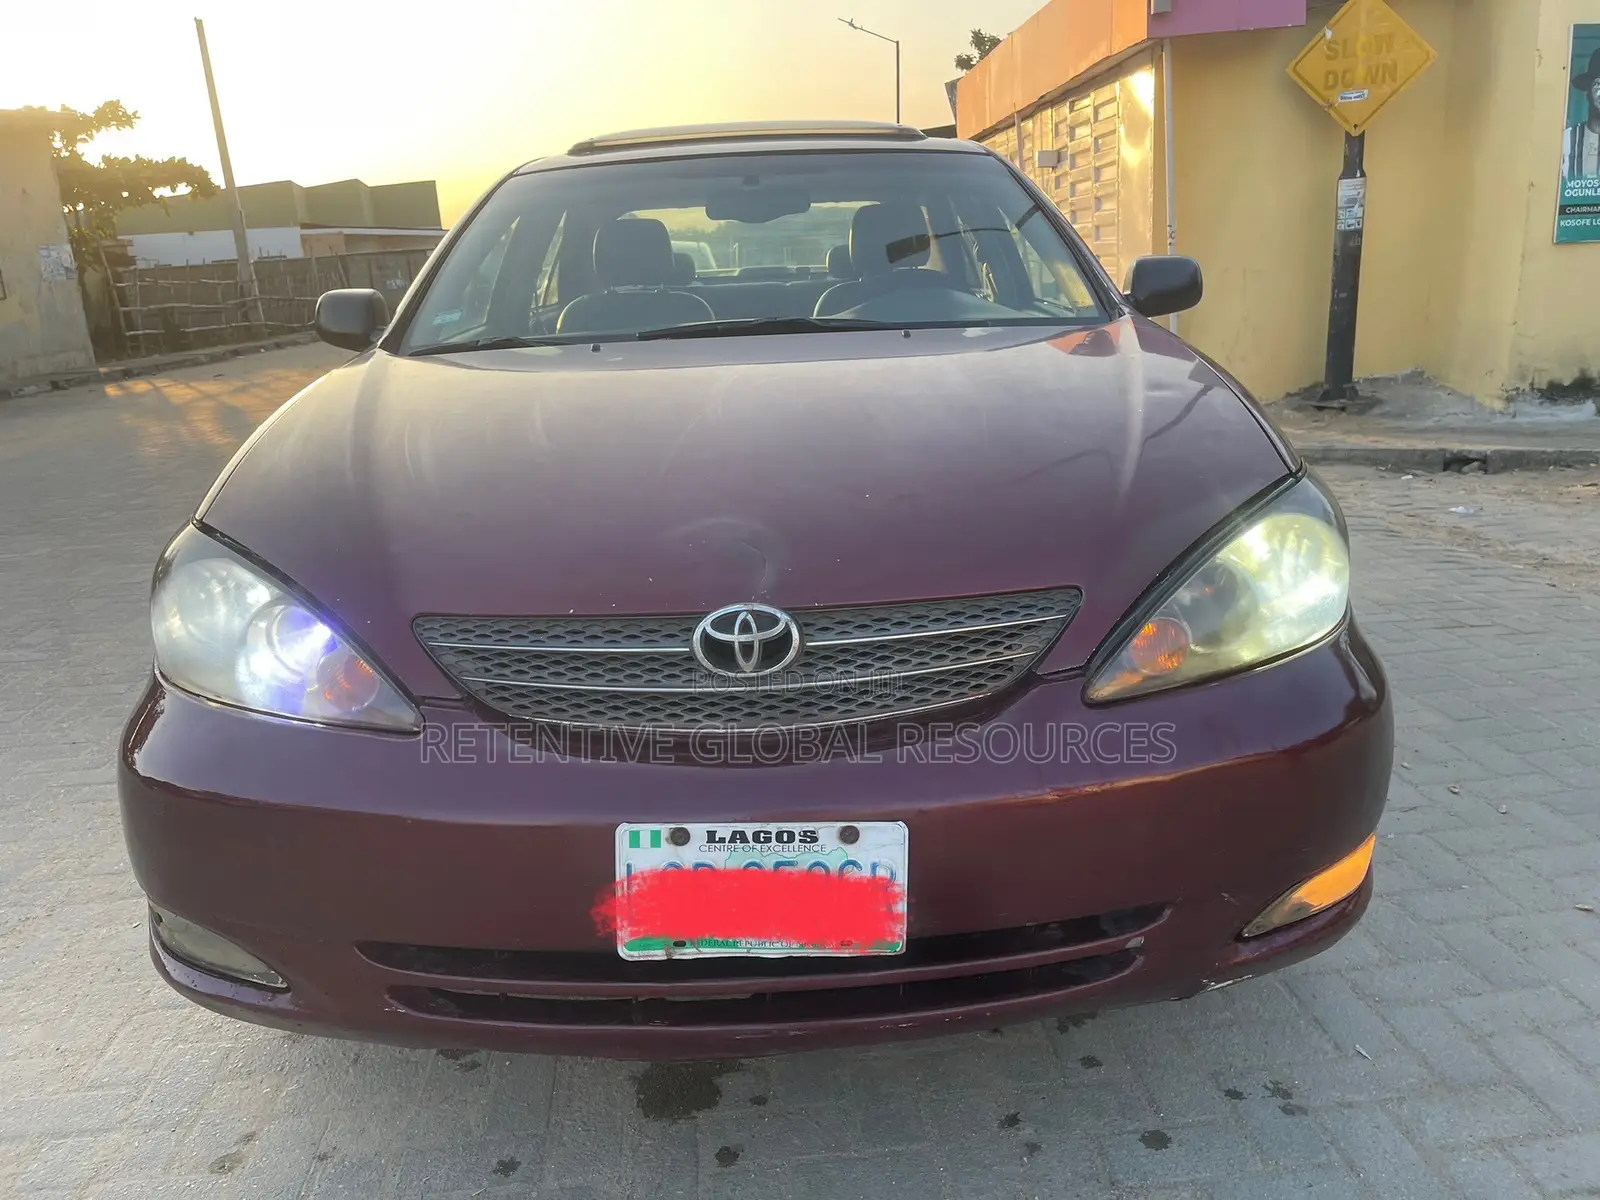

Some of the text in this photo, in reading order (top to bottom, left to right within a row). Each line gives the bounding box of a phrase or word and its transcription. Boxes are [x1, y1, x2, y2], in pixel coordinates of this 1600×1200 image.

[1325, 33, 1396, 61] SLOW
[1323, 59, 1398, 90] DOWN
[1560, 219, 1591, 227] KOSOFE
[705, 830, 819, 844] LAGOS
[698, 844, 827, 853] CENTRE OF EXCELLENCE
